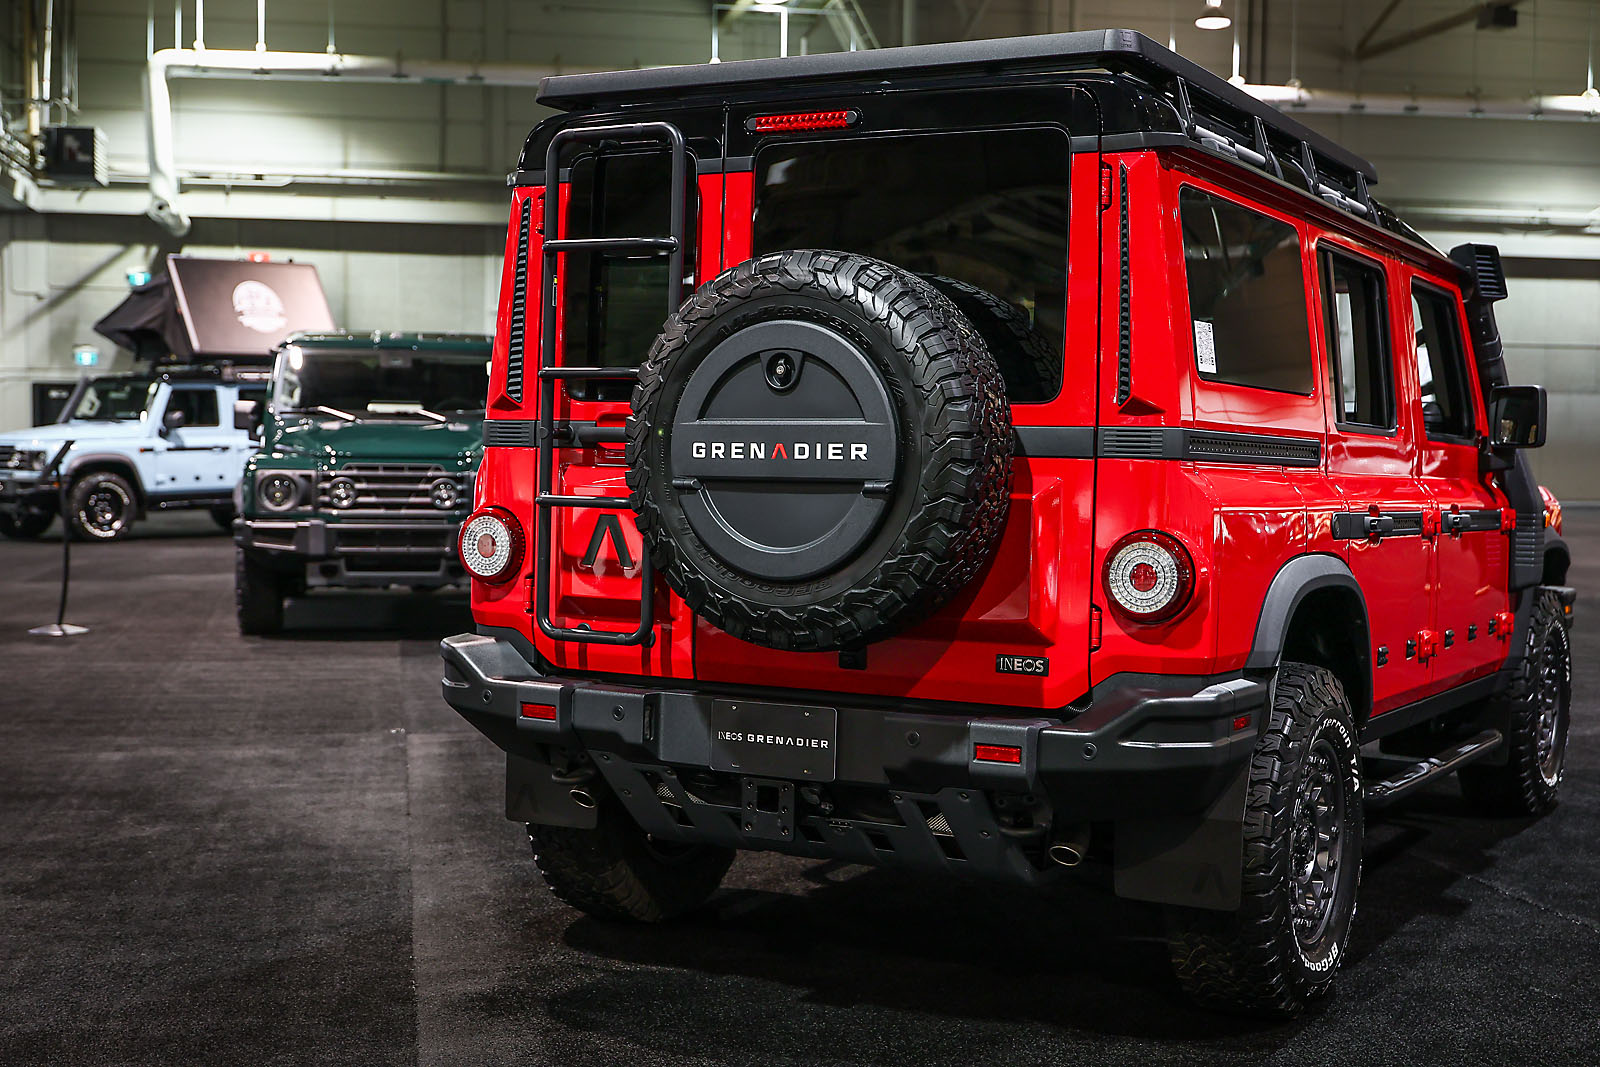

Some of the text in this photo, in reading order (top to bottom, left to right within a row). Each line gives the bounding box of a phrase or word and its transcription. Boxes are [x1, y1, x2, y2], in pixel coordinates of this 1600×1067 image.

[692, 441, 868, 461] GRENADIER
[999, 657, 1045, 673] INEOS
[718, 731, 829, 749] INEOS GRENADIER
[1310, 718, 1360, 793] -Terrain T/A
